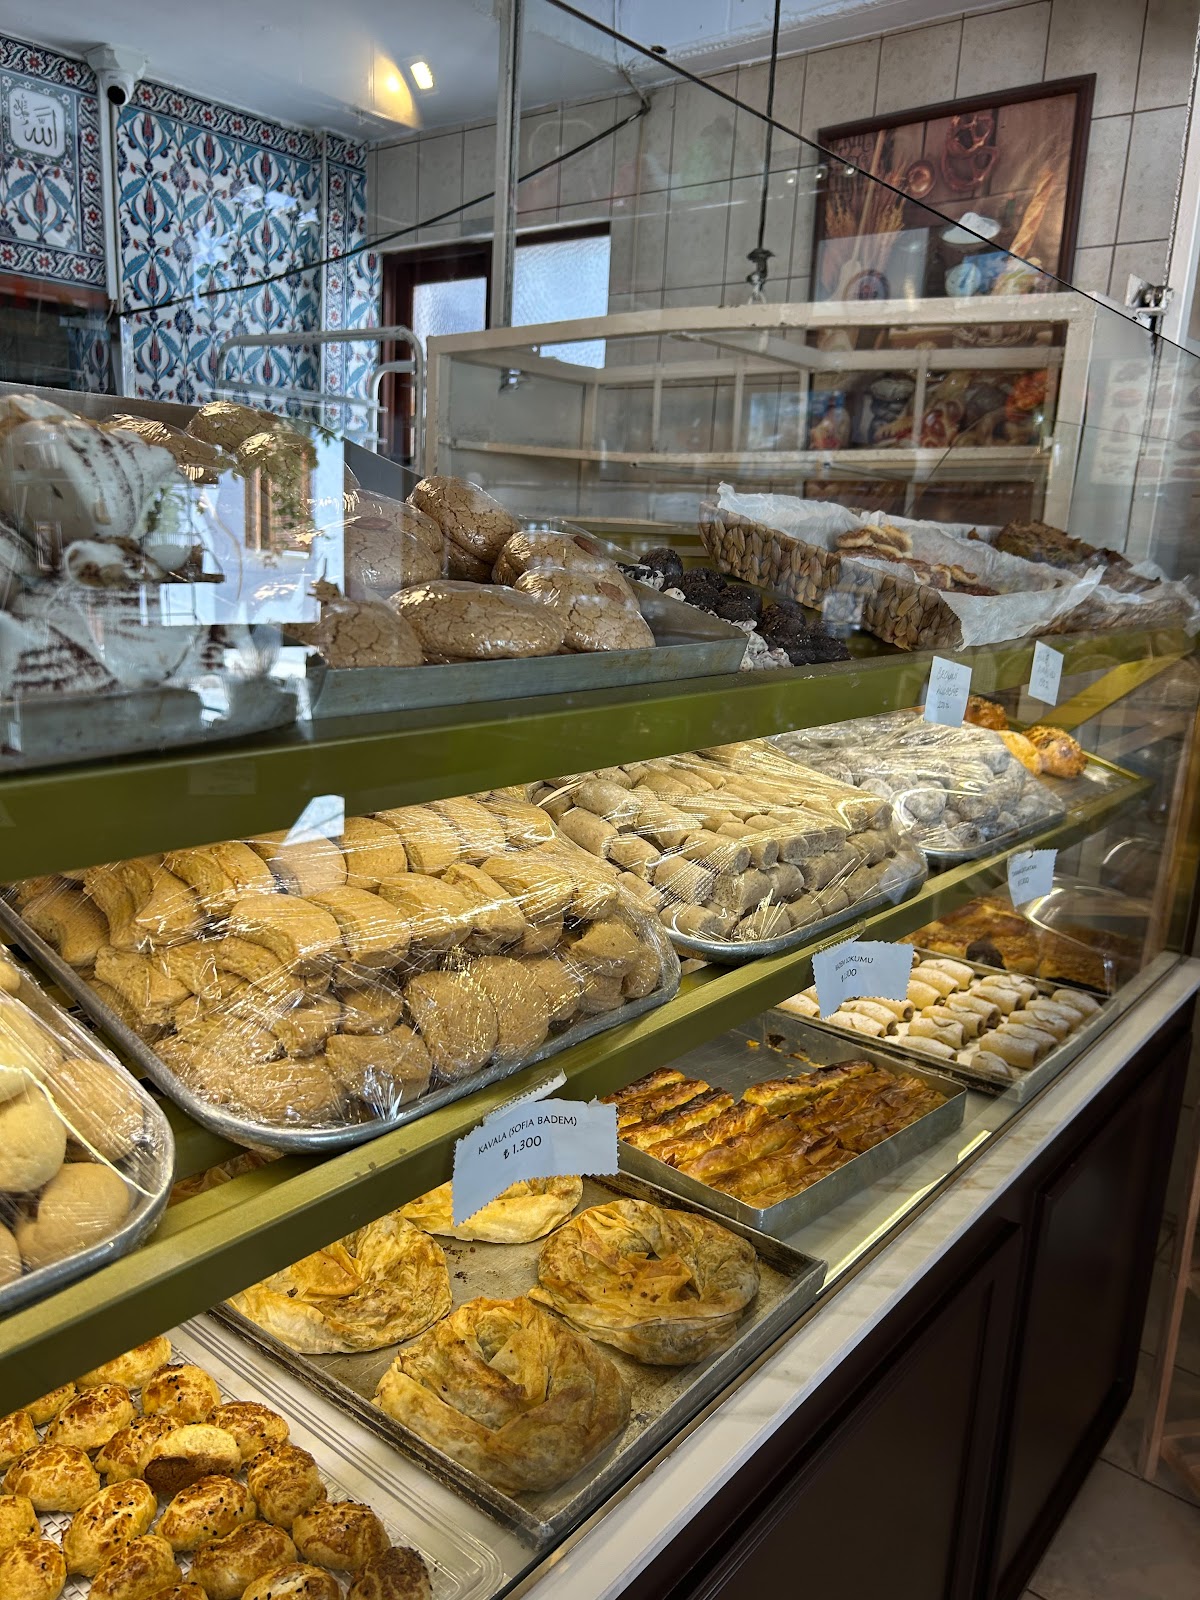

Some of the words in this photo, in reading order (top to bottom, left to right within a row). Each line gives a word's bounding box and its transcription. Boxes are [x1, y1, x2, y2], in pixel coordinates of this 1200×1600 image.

[478, 1132, 507, 1155] KAVALA
[508, 1119, 535, 1139] (SOFIA
[537, 1115, 577, 1127] BADEM)
[513, 1135, 542, 1155] 1.300
